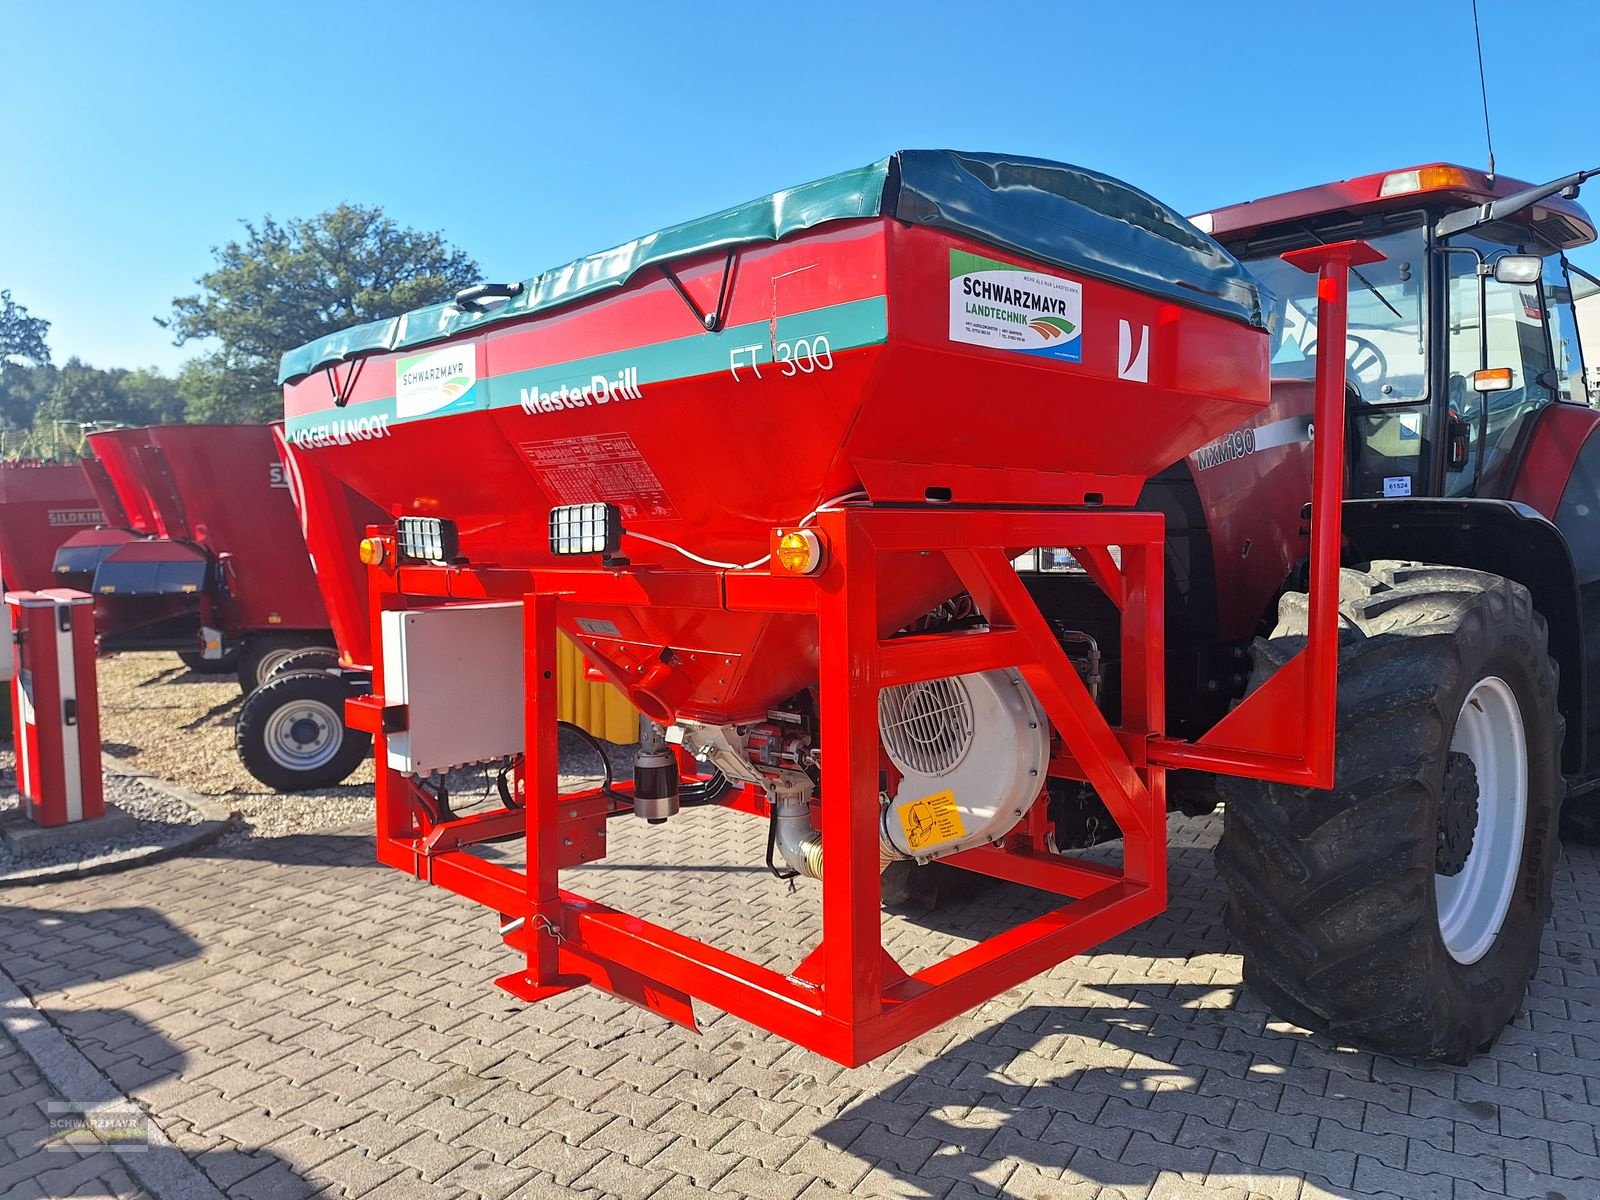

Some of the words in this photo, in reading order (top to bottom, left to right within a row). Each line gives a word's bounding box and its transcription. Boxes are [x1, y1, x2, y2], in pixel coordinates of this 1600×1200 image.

[963, 276, 1067, 316] SCHWARZMAYR
[965, 301, 1028, 326] LANDTECHNIK
[403, 362, 464, 386] SCHWARZMAYR
[729, 343, 763, 382] FT
[777, 335, 834, 377] 300
[520, 367, 642, 415] MasterDrill
[292, 424, 337, 450] VOGEL
[347, 413, 391, 442] NOOT
[1197, 428, 1256, 471] MXM190
[1388, 482, 1408, 490] 61524
